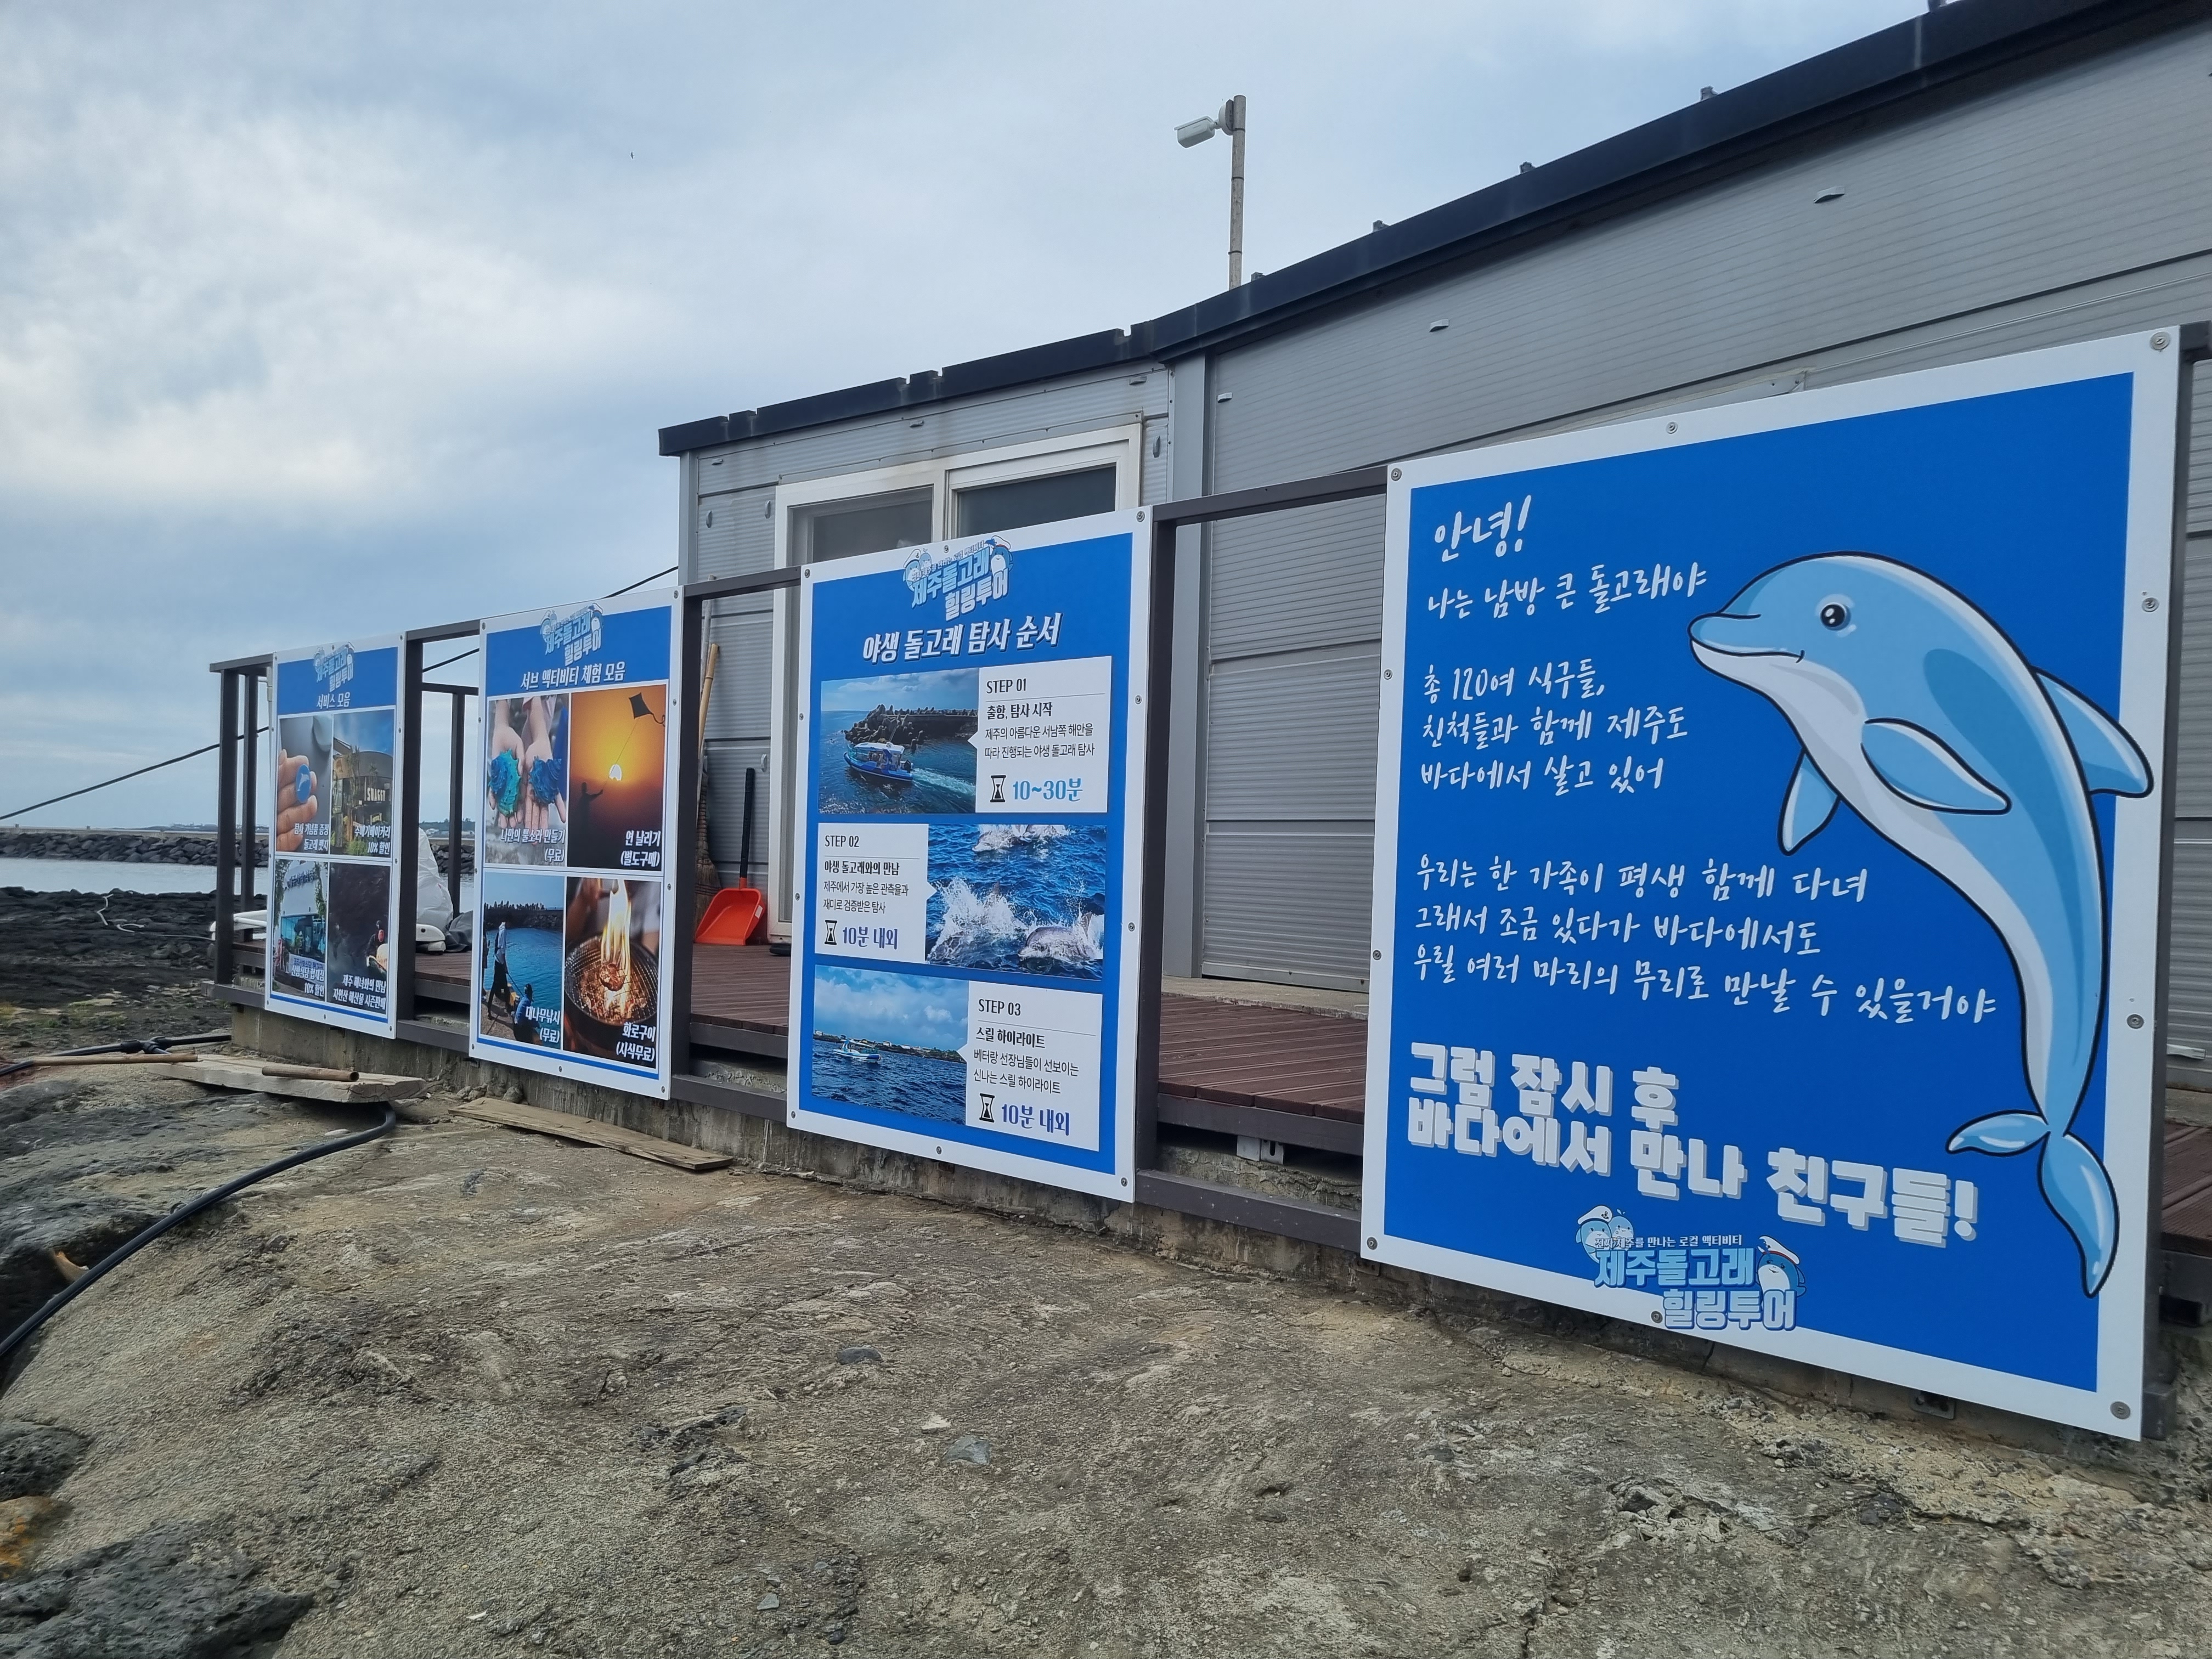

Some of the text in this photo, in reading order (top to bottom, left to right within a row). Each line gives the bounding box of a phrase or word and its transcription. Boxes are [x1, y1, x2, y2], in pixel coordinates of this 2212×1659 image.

[1435, 495, 1531, 562] 안녕!
[912, 546, 990, 609] 제주돌고래
[945, 568, 1009, 622] 힐링투어
[1429, 562, 1706, 619] 나는 남방 큰 돌고래야
[862, 612, 1063, 664] 야생 돌고래 탐사 순서
[521, 661, 625, 690] 서브 액티비티 체험 모음
[1425, 659, 1604, 703] 총 120여 식구들,
[986, 679, 1026, 693] STEP 01
[317, 692, 350, 709] 서비스 모음
[987, 702, 1053, 720] 출항, 탐사 시작
[985, 723, 1093, 740] 제주의 아름다운 서남쪽 해안을
[1423, 706, 1687, 749] 친척들과 함께 제주도
[985, 742, 1095, 759] 따라 진행되는 야생 돌고래 탐사
[1421, 755, 1663, 795] 바다에서 살고 있어
[1013, 777, 1084, 802] 10~30분
[304, 823, 318, 835] 기념품
[319, 824, 329, 836] 증정
[501, 828, 565, 844] 나만의 뿔소라 만들기
[626, 830, 661, 847] 연 날리기
[304, 839, 318, 850] 돌고래
[368, 842, 390, 854] 10% 할인
[825, 835, 860, 848] STEP 02
[545, 848, 565, 862] (무료)
[620, 850, 660, 867] (별도구매)
[825, 860, 900, 876] 야생 돌고래와의 만남
[1417, 854, 1866, 901] 우리는 한 가족이 평생 함께 다녀
[824, 881, 909, 896] 제주에서 가장 높은 관측율과
[823, 899, 886, 914] 재미로 검증받은 탐사
[843, 927, 898, 950] 10분 내외
[1416, 902, 1820, 955] 그래서 조금 있다가 바다에서도
[292, 966, 309, 978] 산방식당
[305, 983, 324, 997] 10% 할인
[342, 974, 386, 994] 제주 해녀와의 만남
[1414, 944, 1995, 1023] 우릴 여러 마리의 무리로 만날 수 있을거야
[333, 989, 348, 1002] 자연산
[349, 991, 364, 1005] 해산물
[978, 998, 1021, 1015] STEP 03
[526, 1006, 561, 1025] 대나무낚시
[540, 1027, 560, 1043] (무료)
[622, 1022, 656, 1042] 화로구이
[976, 1027, 1045, 1048] 스릴 하이라이트
[616, 1041, 655, 1062] (시식무료)
[974, 1049, 1079, 1077] 베터랑 선장님들이 선보이는
[973, 1069, 1061, 1093] 신나는 스릴 하이라이트
[1410, 1042, 1678, 1132] 그럼 잠시 후
[1002, 1104, 1069, 1136] 10분 내외
[1409, 1098, 1978, 1249] 바다에서 만나 친구들!
[1595, 1234, 1742, 1249] 진짜 제주를 만나는 로컬 액티비티
[1595, 1248, 1756, 1288] 제주돌고래
[1663, 1289, 1797, 1330] 힐링투어
